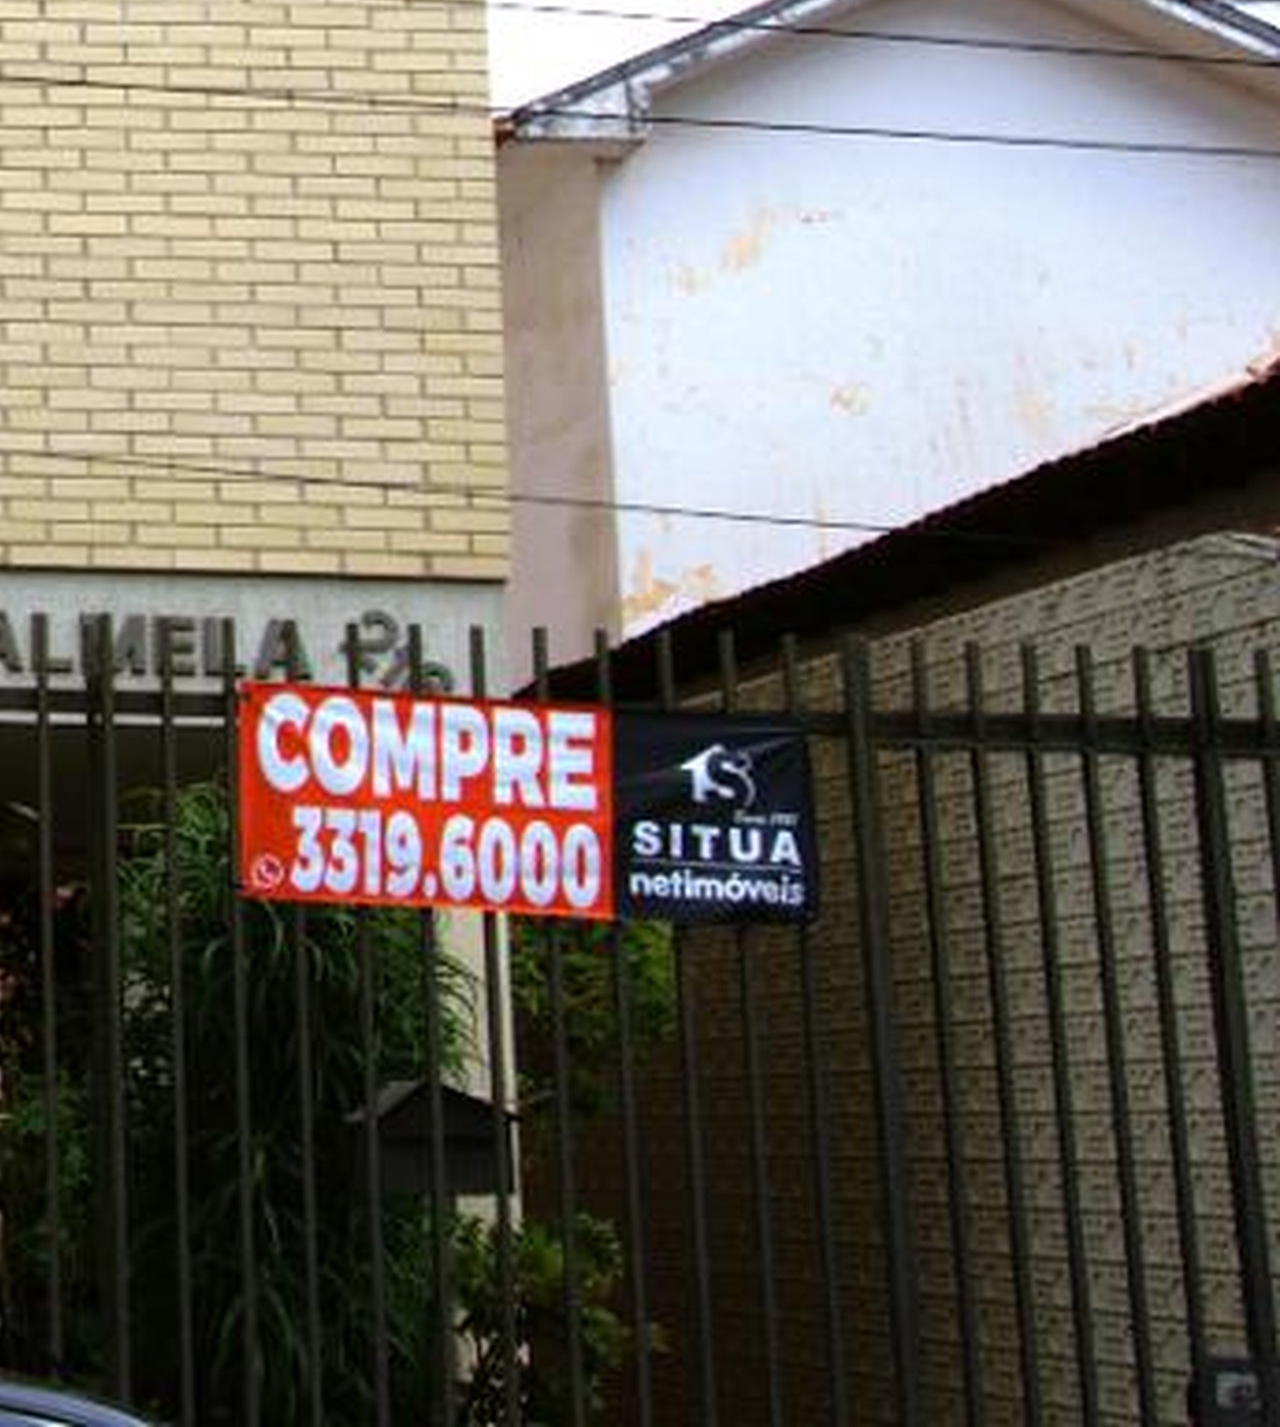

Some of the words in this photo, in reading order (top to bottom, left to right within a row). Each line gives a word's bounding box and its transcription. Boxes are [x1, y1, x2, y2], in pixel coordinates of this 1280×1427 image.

[257, 691, 598, 811] COMPRE
[290, 805, 601, 908] 3319.6000
[632, 820, 802, 866] SITUA
[629, 869, 806, 906] netimóveis
